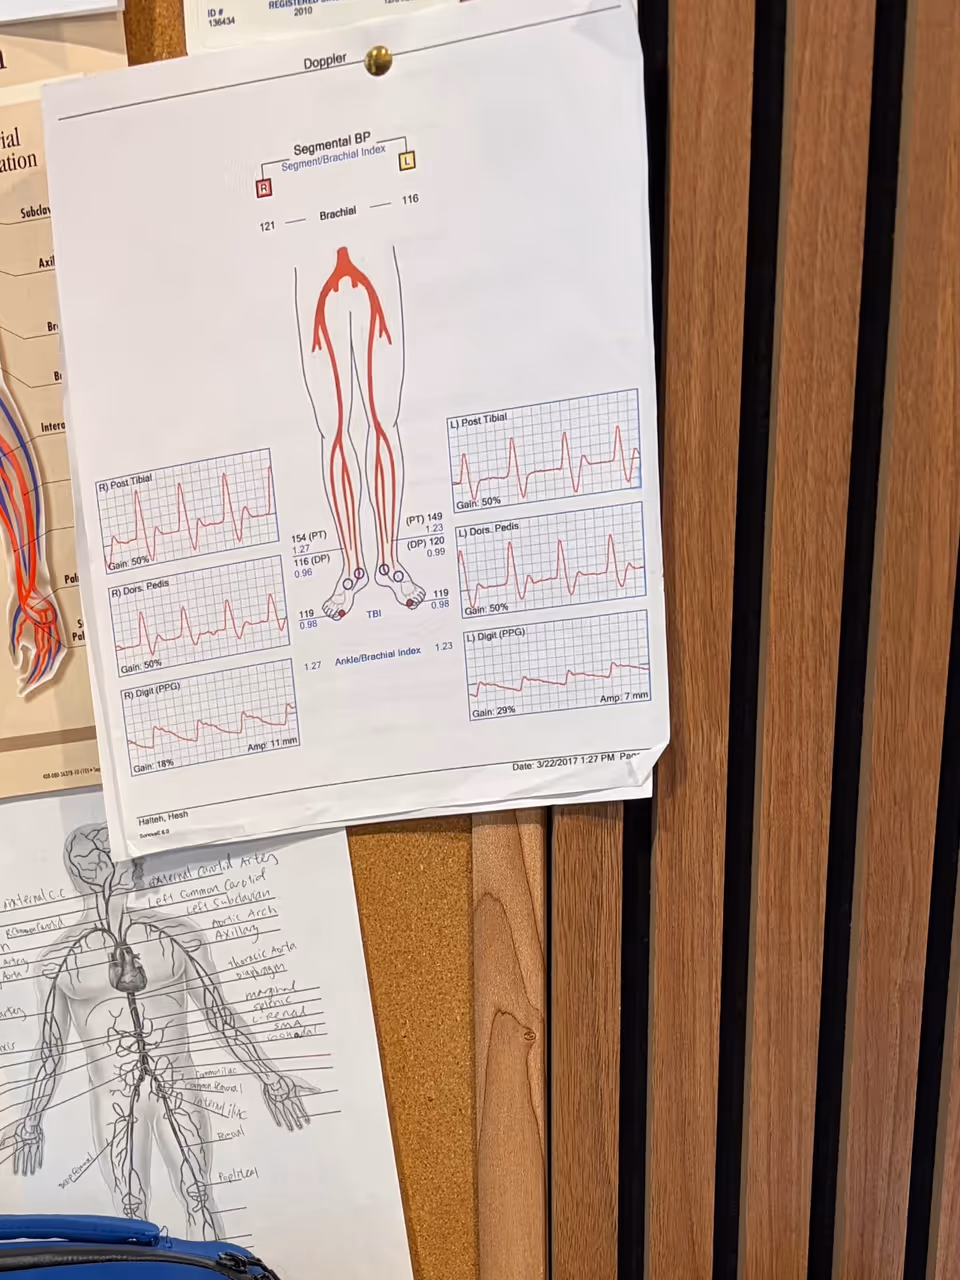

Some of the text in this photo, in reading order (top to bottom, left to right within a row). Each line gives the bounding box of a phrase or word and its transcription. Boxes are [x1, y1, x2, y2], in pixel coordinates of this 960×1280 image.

[207, 8, 223, 17] ID #
[294, 7, 312, 16] 2010
[209, 16, 235, 27] 136434
[303, 53, 347, 72] Doppler
[294, 131, 371, 156] Segmental BP
[281, 143, 386, 172] Segment/Brachial Index
[260, 193, 419, 232] 121 Brachial 116
[451, 413, 507, 429] L) Post Tibial
[406, 512, 443, 526] (PT) 149
[426, 524, 444, 533] 1.23
[366, 609, 382, 619] TBI
[335, 647, 421, 666] Ankle/Brachial Index
[513, 754, 615, 771] Date: 3/22/2017 1:27 PM
